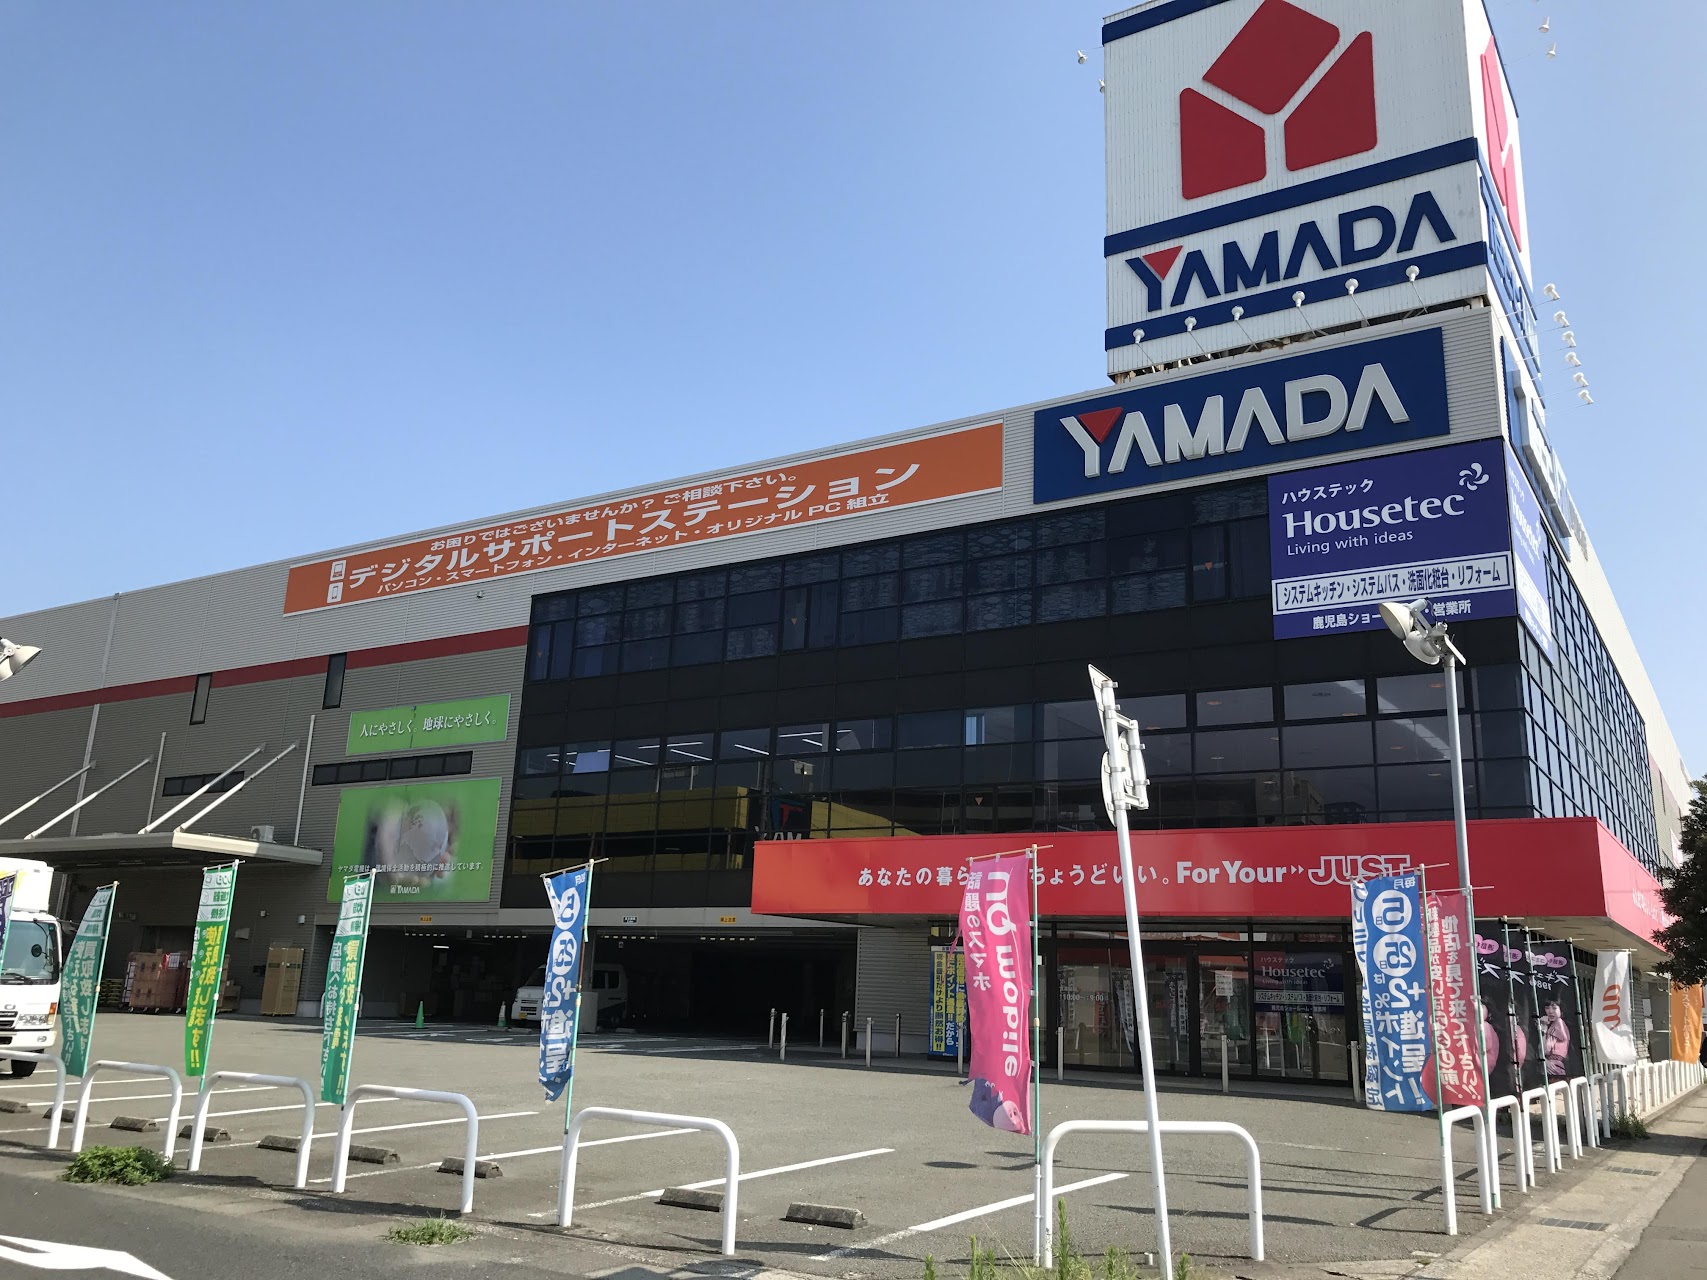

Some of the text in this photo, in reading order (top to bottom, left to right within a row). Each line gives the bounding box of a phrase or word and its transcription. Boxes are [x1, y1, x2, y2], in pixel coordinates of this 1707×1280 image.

[1125, 191, 1456, 312] YAMADA
[1059, 363, 1410, 478] YAMADA
[808, 501, 841, 517] PC
[845, 493, 890, 510] 組立
[1282, 478, 1374, 504] ハウステック
[349, 463, 921, 589] デジタルサポートステーション
[1282, 493, 1465, 538] Housetec
[1287, 529, 1414, 556] Living with ideas
[360, 711, 497, 737] 人にやさしく。 地球にやさしく。
[1177, 861, 1219, 883] For
[1222, 860, 1286, 884] Your
[1308, 855, 1410, 885] JUST
[1261, 966, 1325, 978] Housetec
